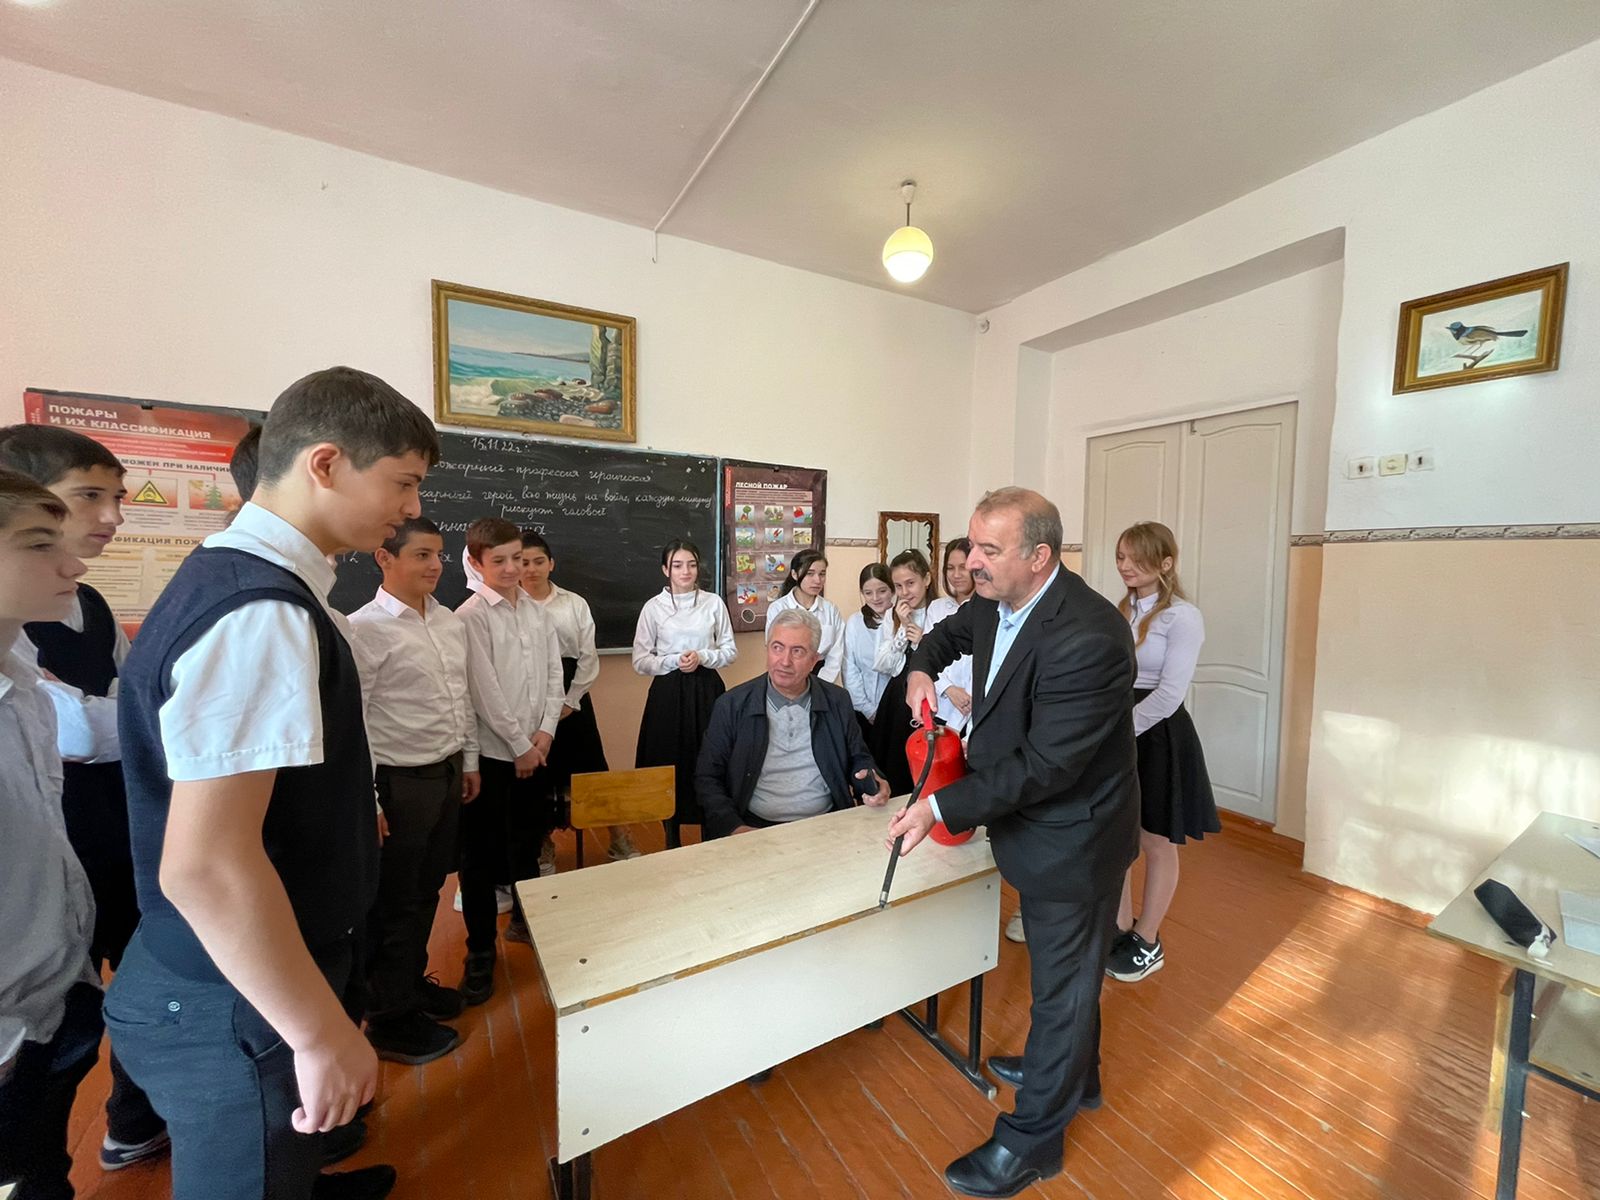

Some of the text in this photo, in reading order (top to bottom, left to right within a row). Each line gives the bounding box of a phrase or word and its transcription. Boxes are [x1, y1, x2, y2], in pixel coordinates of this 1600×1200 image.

[48, 404, 118, 419] ПОЖАРЫ
[49, 415, 60, 424] И
[65, 417, 87, 427] ИХ
[90, 420, 211, 439] КЛАССИФИКАЦИЯ
[120, 458, 160, 468] МОЖЕН
[434, 461, 505, 477] ожарный
[114, 536, 171, 545] ФИКАЦИЯ
